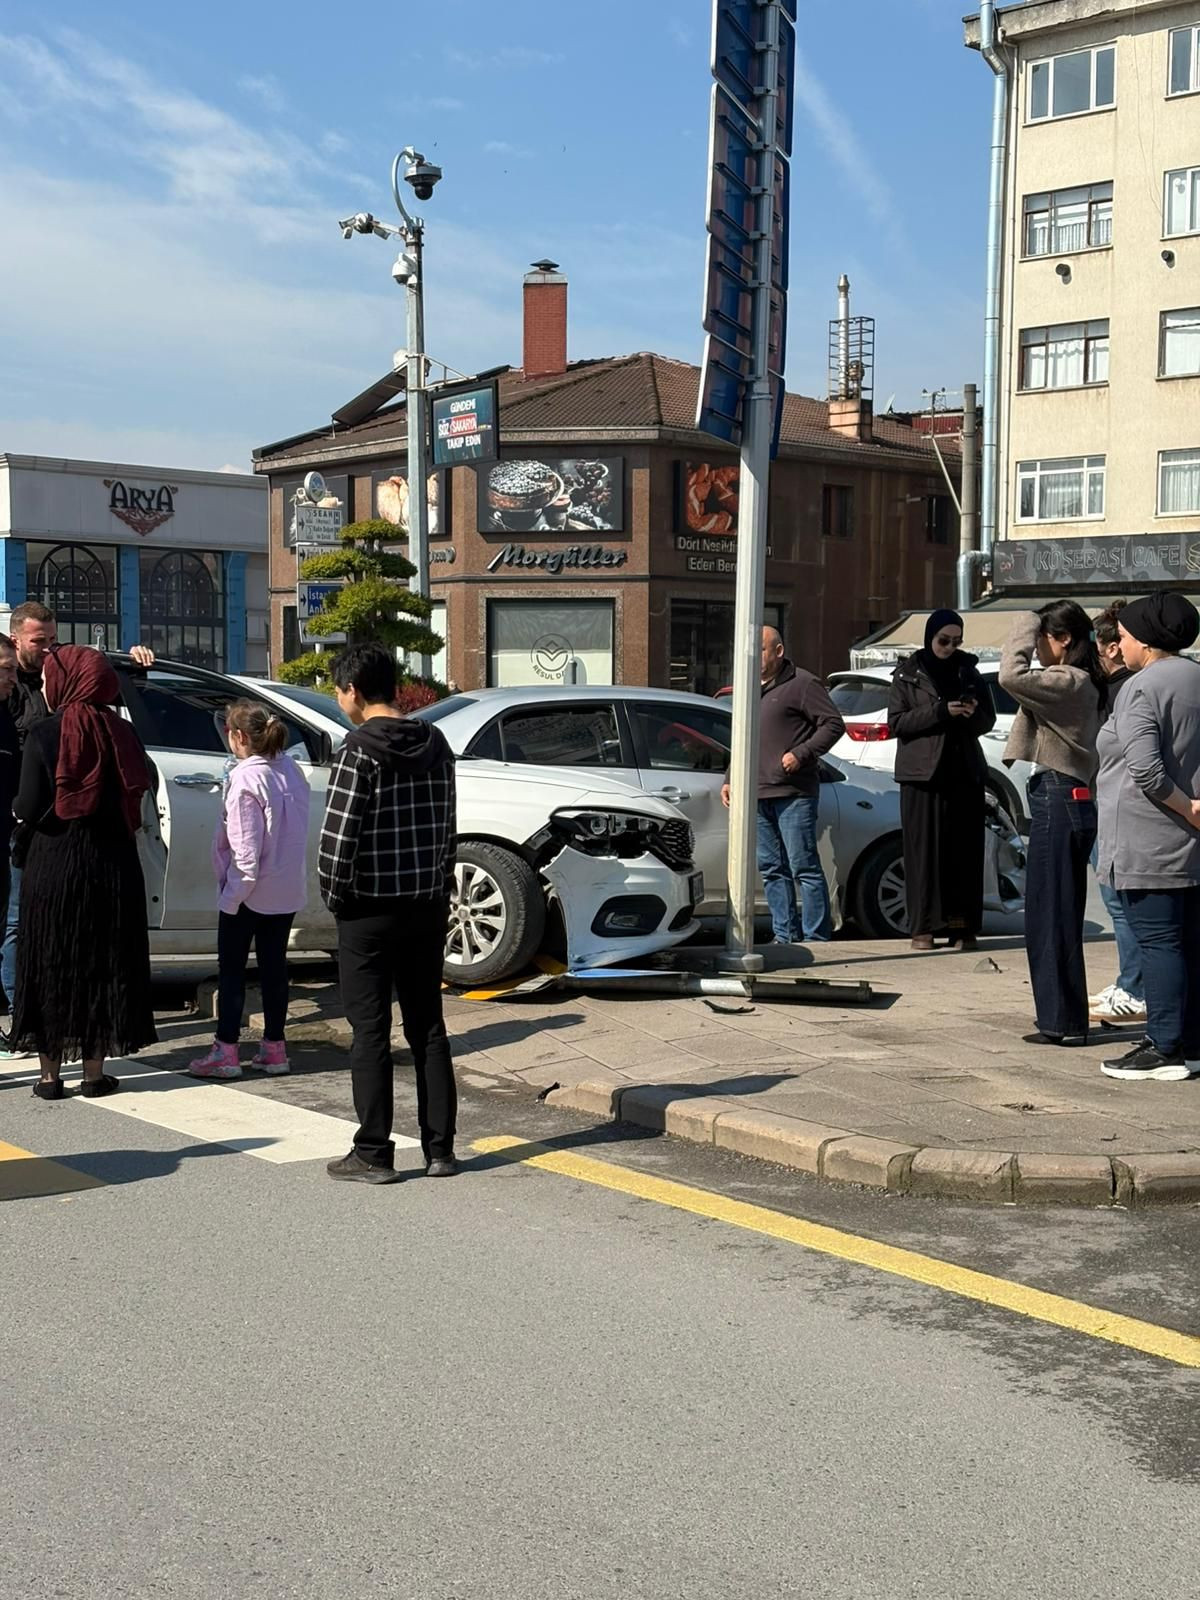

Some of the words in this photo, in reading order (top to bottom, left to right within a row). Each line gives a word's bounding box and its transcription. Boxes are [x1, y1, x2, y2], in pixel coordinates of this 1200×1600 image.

[109, 481, 175, 515] ARYA
[487, 543, 626, 572] Morgüller
[678, 536, 700, 550] Dört
[1036, 543, 1127, 575] KÖŞEBAŞI
[1132, 545, 1180, 568] CAFE
[533, 664, 554, 680] RESUL
